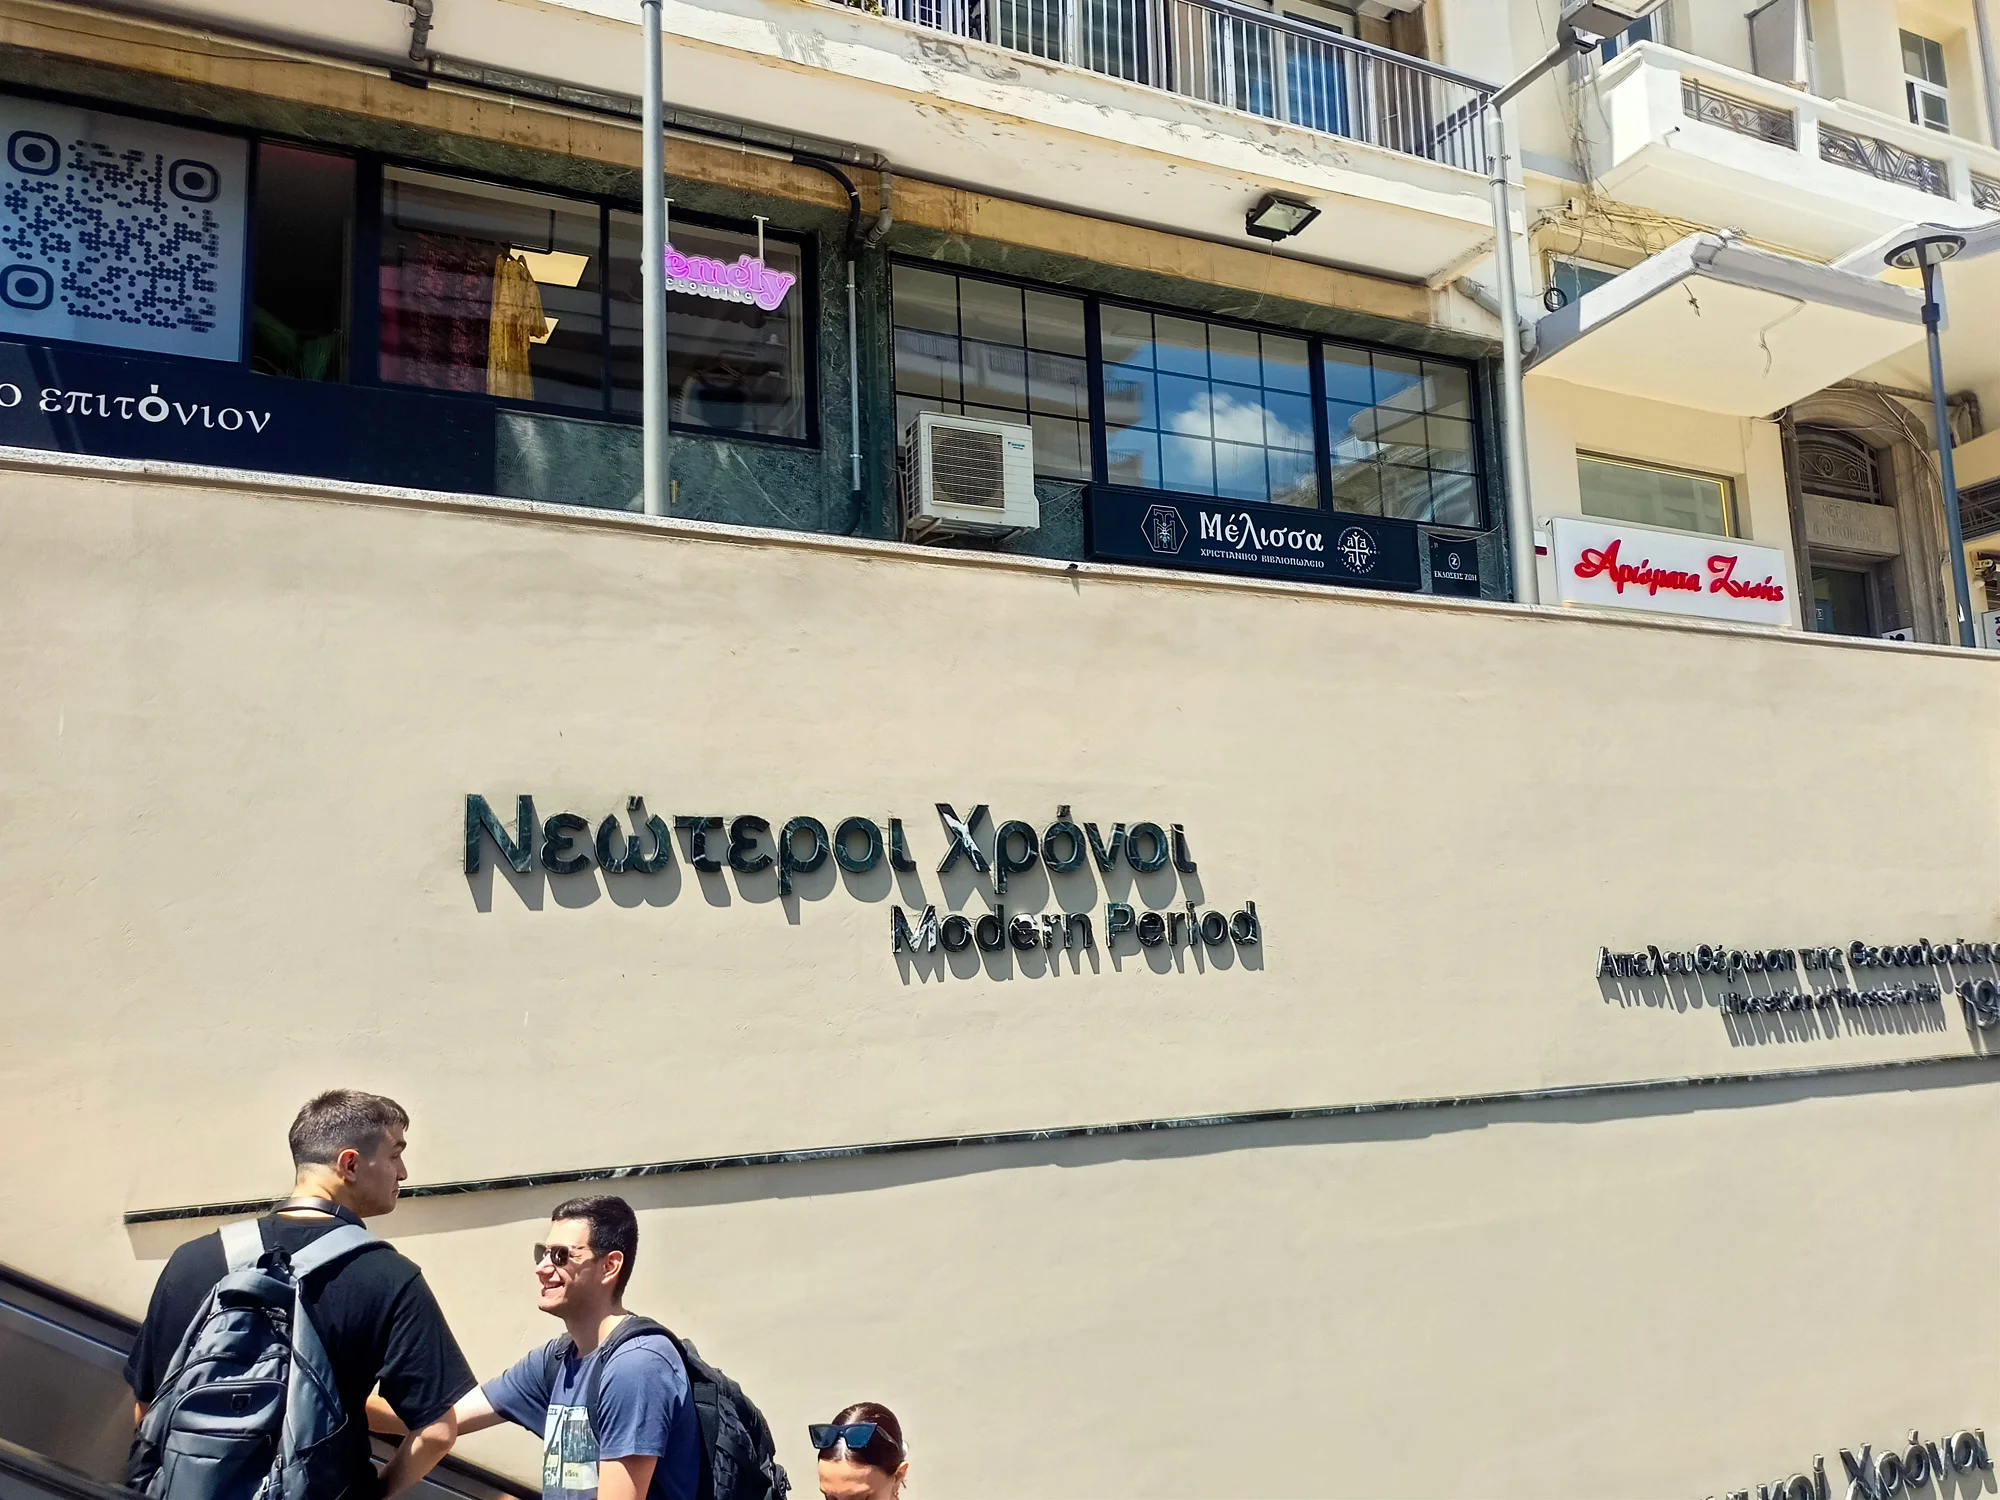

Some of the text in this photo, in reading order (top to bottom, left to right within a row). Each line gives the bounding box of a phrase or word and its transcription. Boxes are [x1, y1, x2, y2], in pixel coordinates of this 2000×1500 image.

[664, 244, 796, 309] emély
[665, 278, 753, 300] CLOTHING
[39, 384, 271, 434] επιτόνιον
[1200, 511, 1324, 552] Μέλισσα
[464, 793, 1197, 896] Νεώτεροι Χρόνοι
[890, 900, 1258, 953] Modern Period
[1798, 946, 1844, 973] της
[1718, 985, 1814, 1015] Liberation
[1839, 1428, 1994, 1500] Χρόνοι
